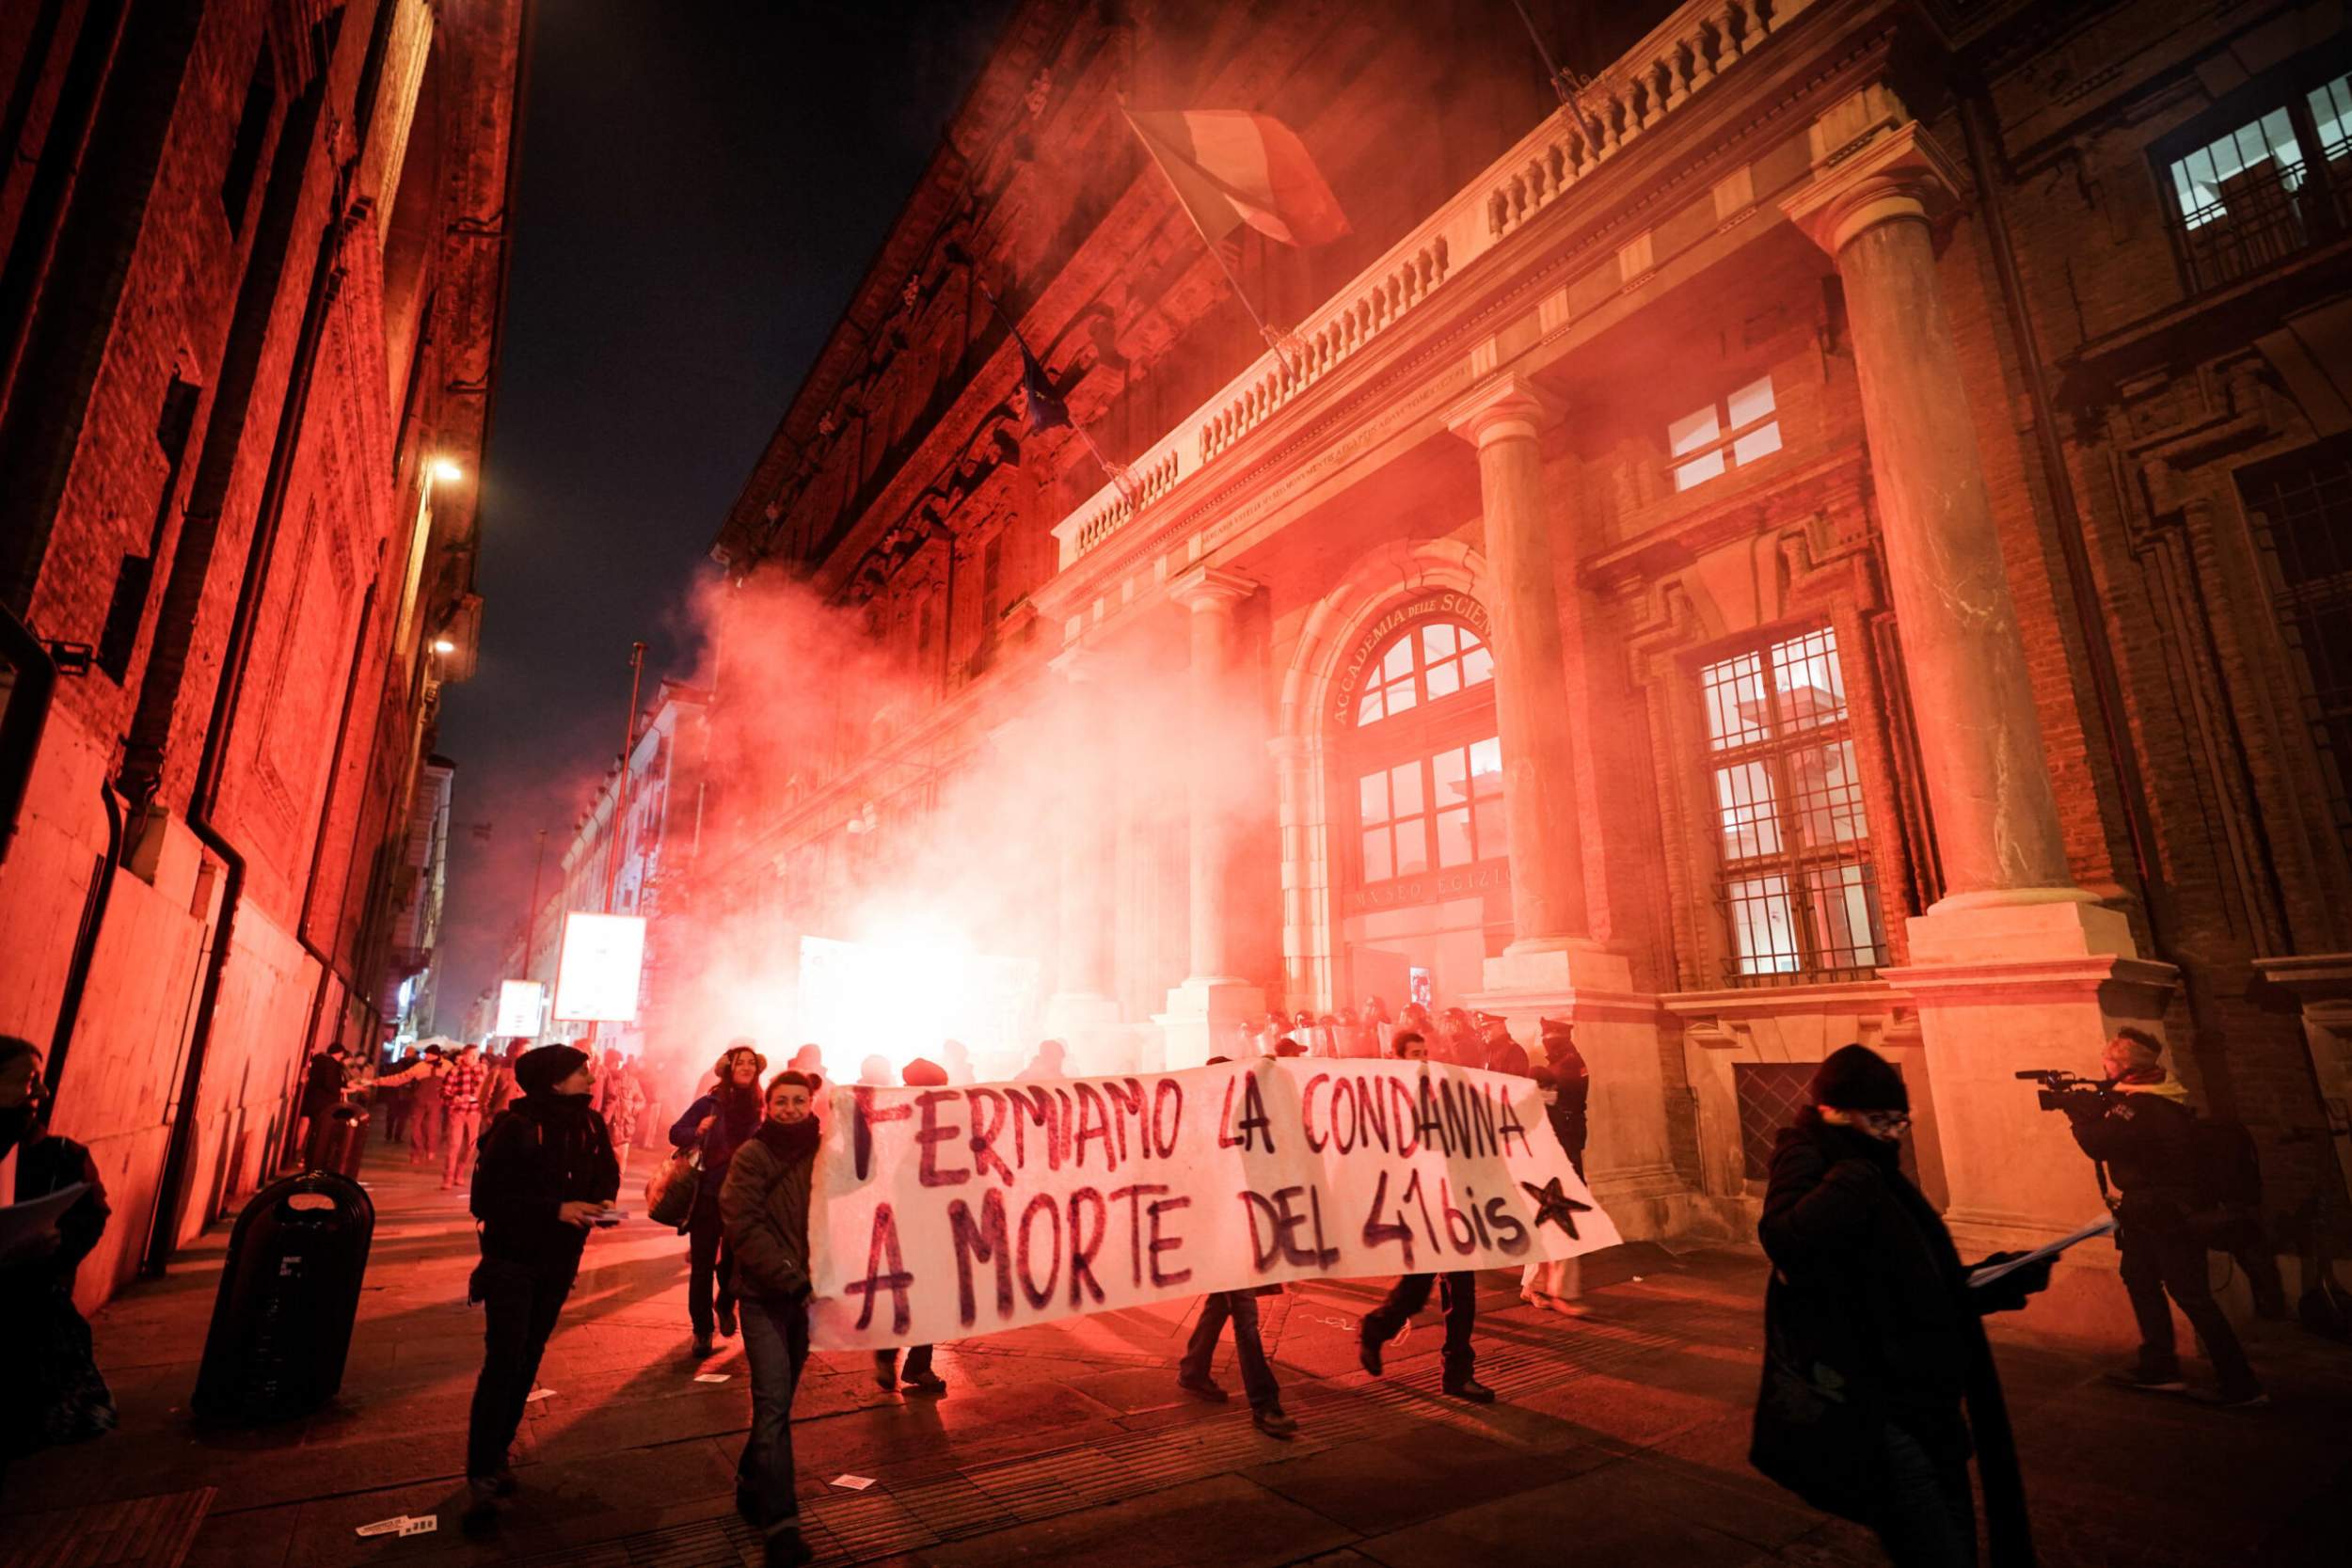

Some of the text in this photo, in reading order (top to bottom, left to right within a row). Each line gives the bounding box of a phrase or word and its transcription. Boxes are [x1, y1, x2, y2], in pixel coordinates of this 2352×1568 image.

[1334, 609, 1406, 726] ACCADEMIA
[1408, 600, 1437, 618] DELLE
[853, 1070, 1534, 1187] FERMIAMO LA CONDANNA
[844, 1202, 914, 1336] A
[947, 1184, 1192, 1328] MORTE
[1237, 1185, 1341, 1274] DEL
